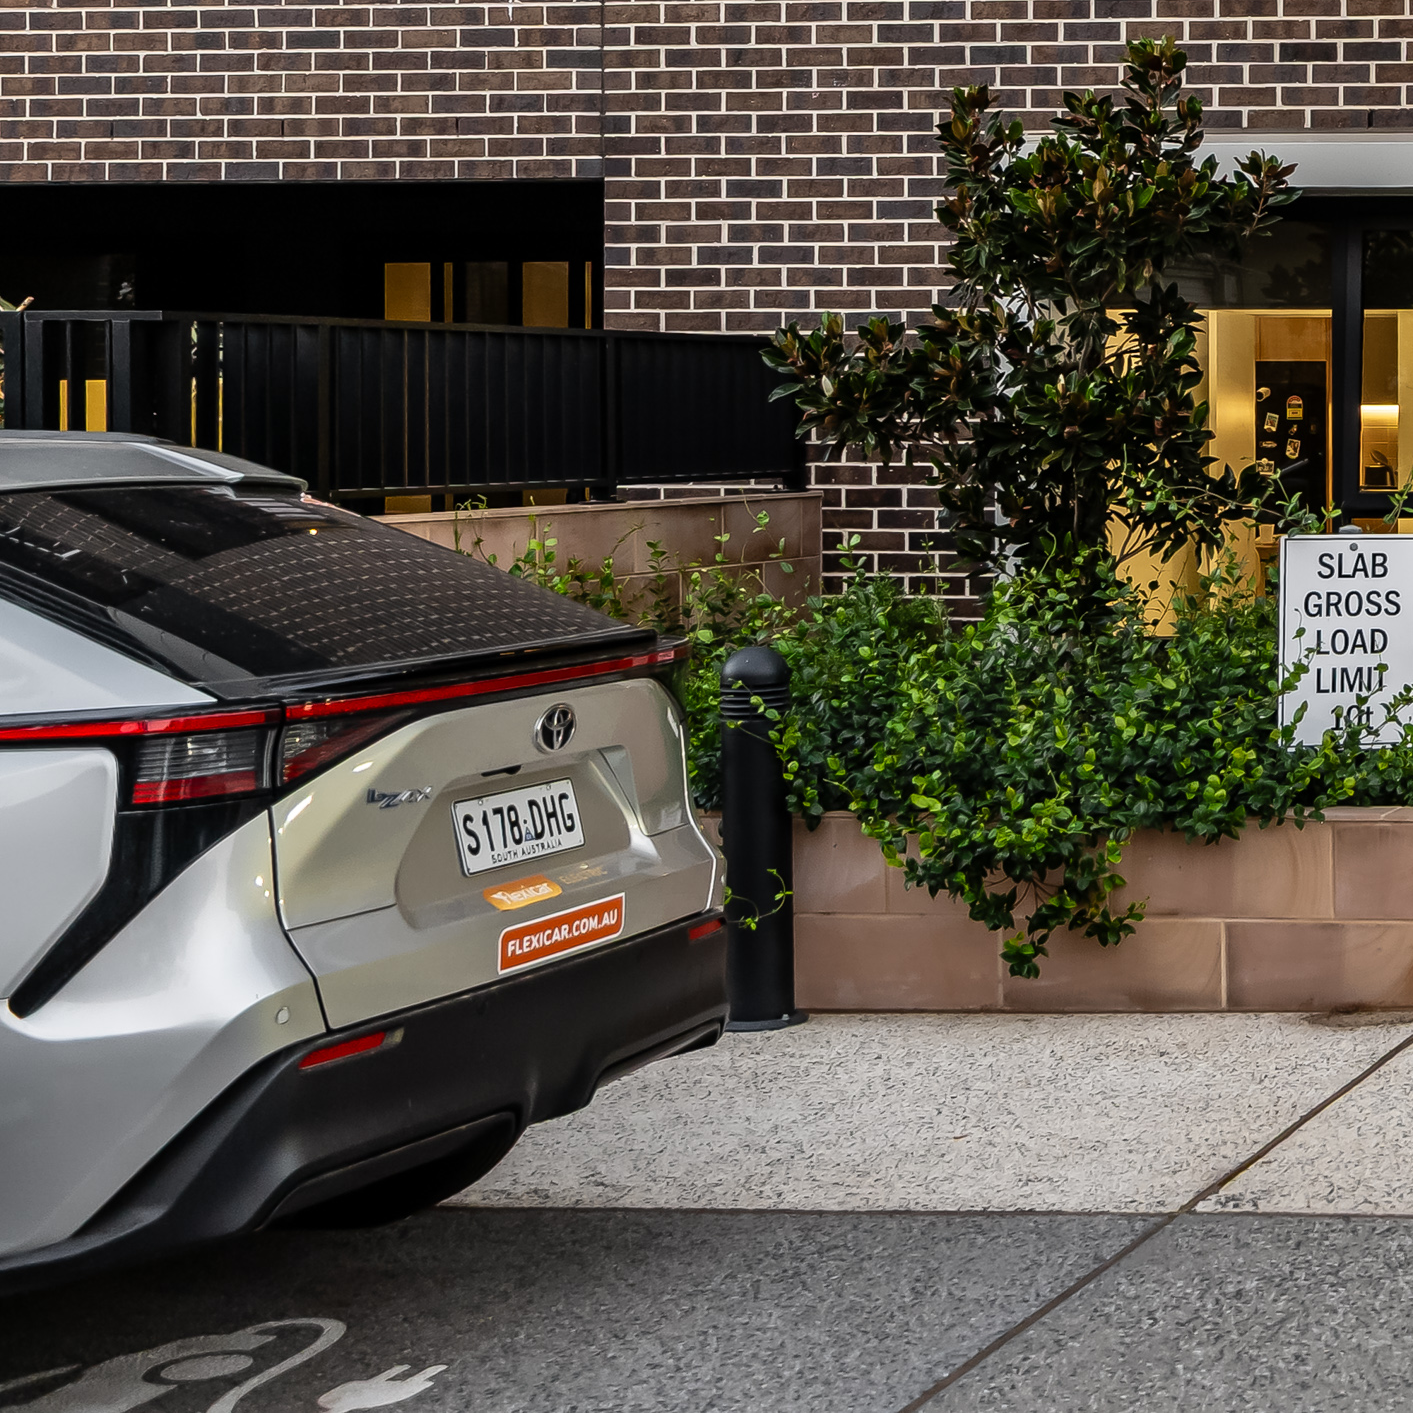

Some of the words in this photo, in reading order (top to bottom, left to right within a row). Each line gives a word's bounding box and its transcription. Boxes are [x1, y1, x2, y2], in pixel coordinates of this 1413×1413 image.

[1317, 553, 1389, 579] SLAB
[1304, 590, 1401, 617] GROSS
[1316, 628, 1388, 655] LOAD
[1316, 666, 1386, 693] LIMIT
[491, 849, 519, 864] SOUTH
[521, 838, 562, 855] AUSTRALIA
[507, 908, 618, 957] FLEXICAR.COM.AU
